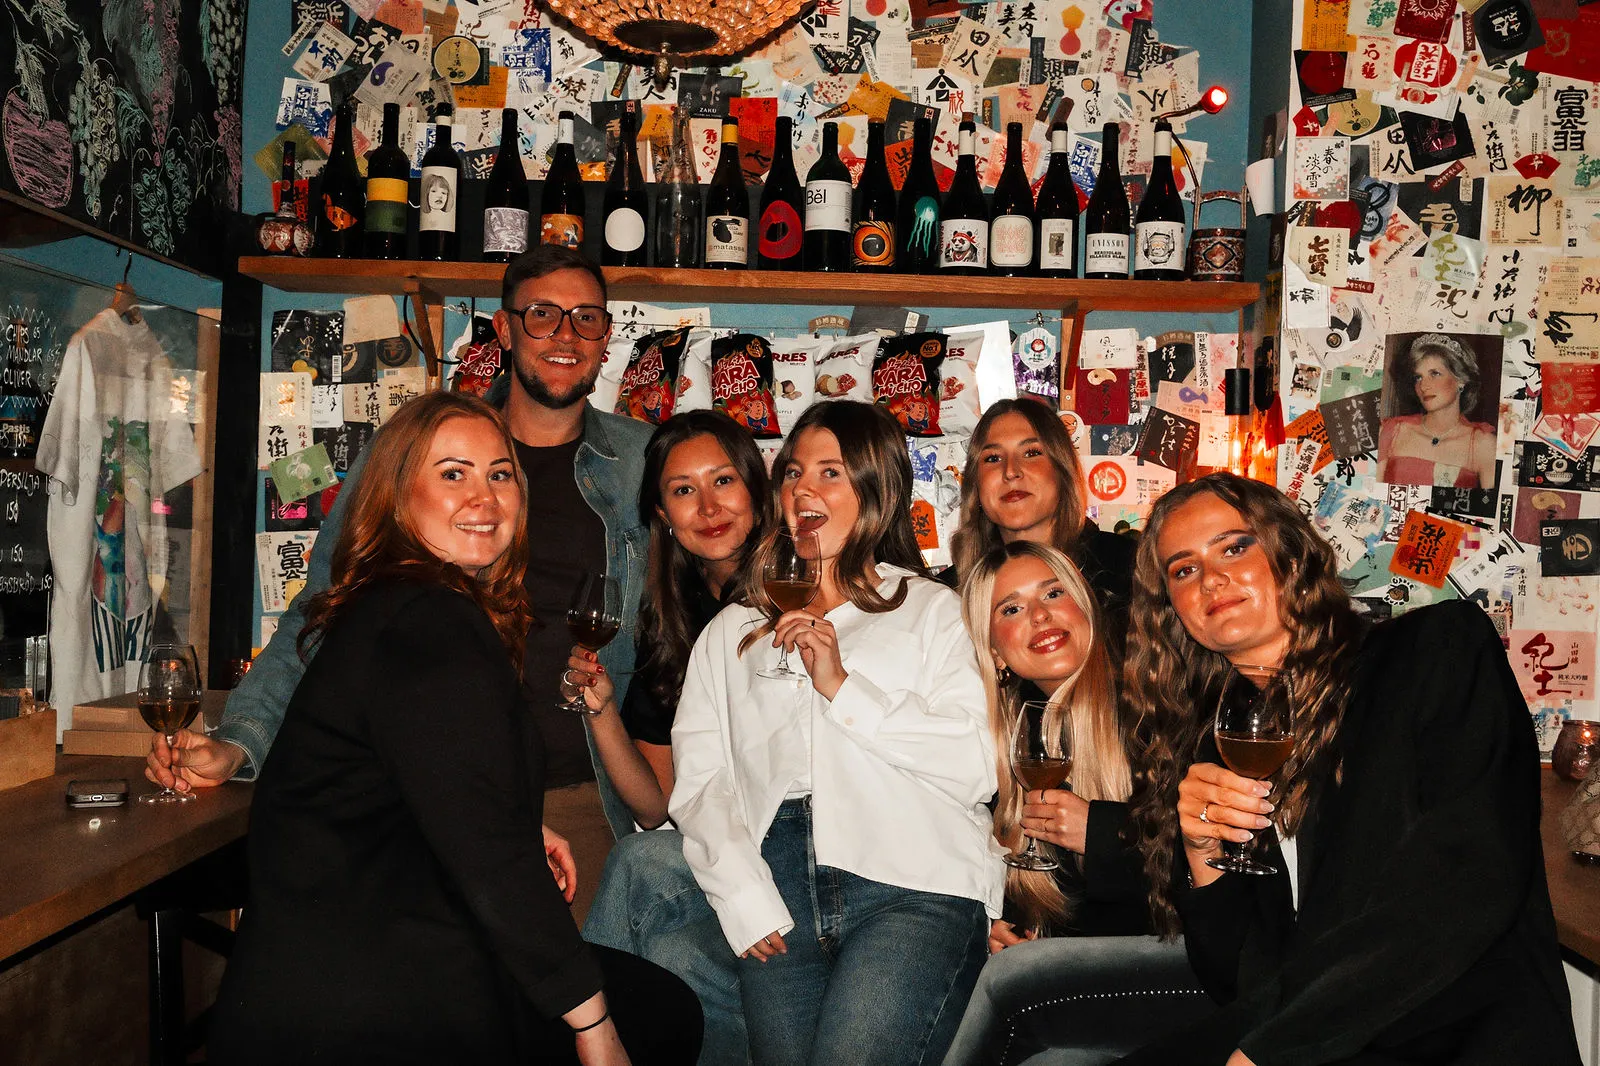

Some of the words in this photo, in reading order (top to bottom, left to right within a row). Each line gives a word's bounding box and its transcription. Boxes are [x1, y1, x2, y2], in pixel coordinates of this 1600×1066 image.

[807, 189, 826, 205] Běl
[5, 324, 29, 344] CHIPS
[33, 326, 40, 339] 65
[6, 345, 42, 364] MANDLAR
[773, 352, 807, 363] RRES
[4, 367, 31, 388] OLIVER
[873, 363, 926, 387] KARA
[879, 381, 922, 397] MUCHO
[2, 424, 30, 434] Pastis
[11, 544, 23, 562] 150
